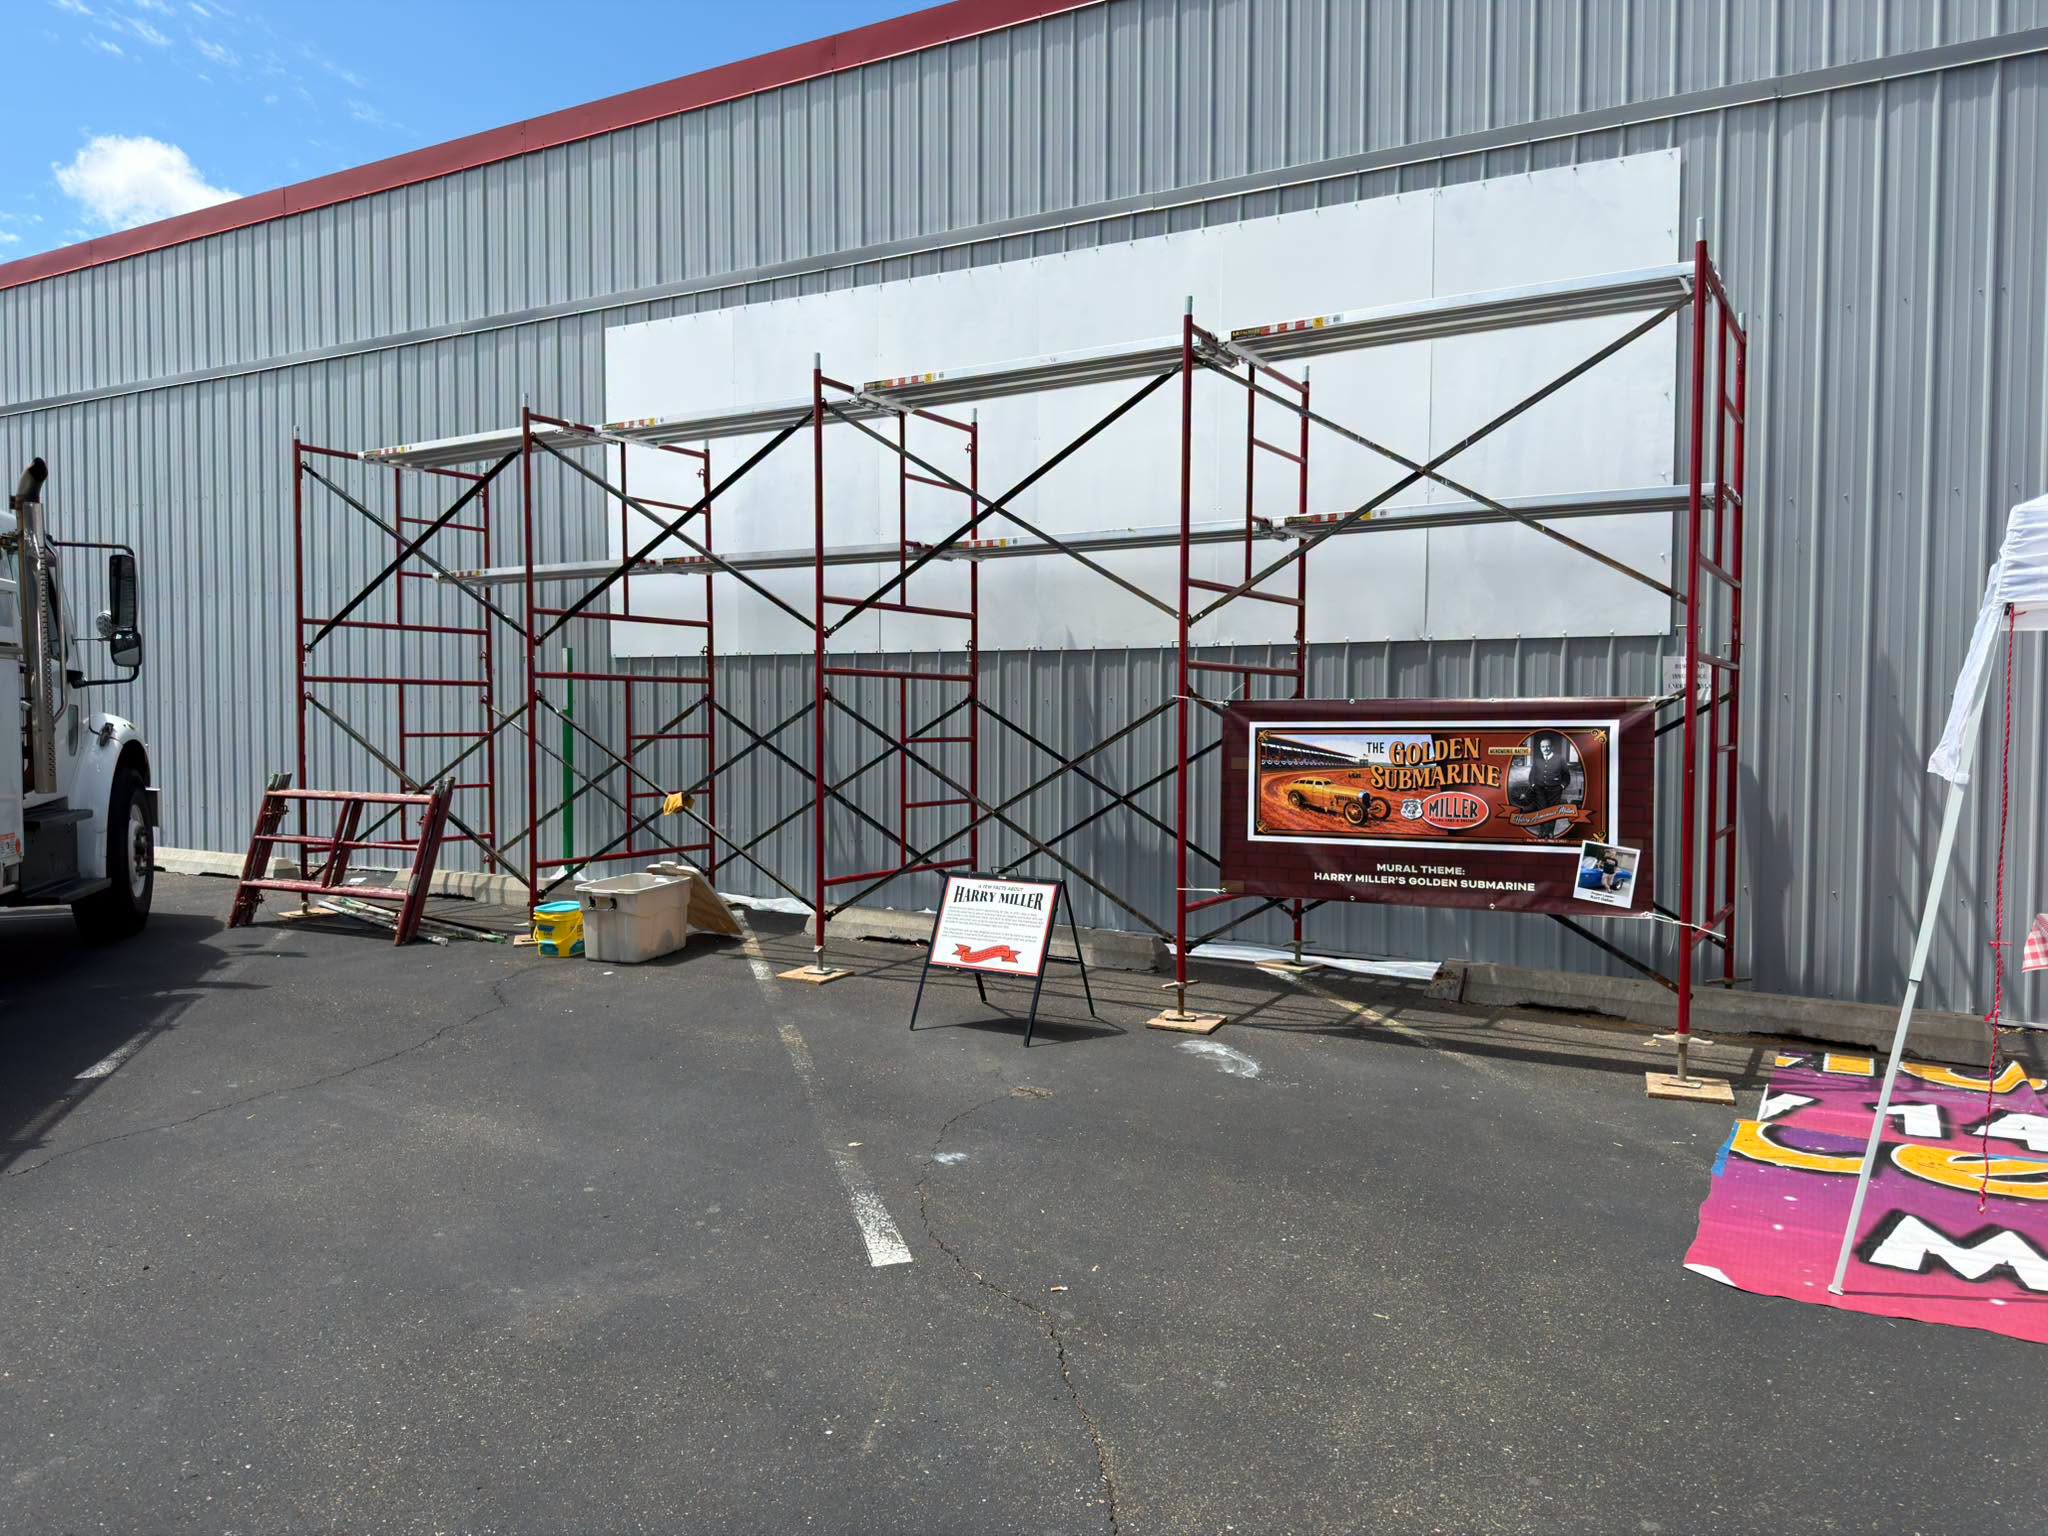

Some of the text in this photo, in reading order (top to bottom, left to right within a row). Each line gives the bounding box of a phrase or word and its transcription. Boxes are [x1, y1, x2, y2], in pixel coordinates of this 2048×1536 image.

[1366, 737, 1480, 766] THE GOLDEN
[1370, 763, 1502, 790] SUBMARINE
[1429, 798, 1478, 818] MILLER
[1376, 863, 1466, 875] MURAL THEME:
[1314, 872, 1536, 891] HARRY MILLER'S GOLDEN SUBMARINE
[953, 885, 1044, 911] HARRY MILLER
